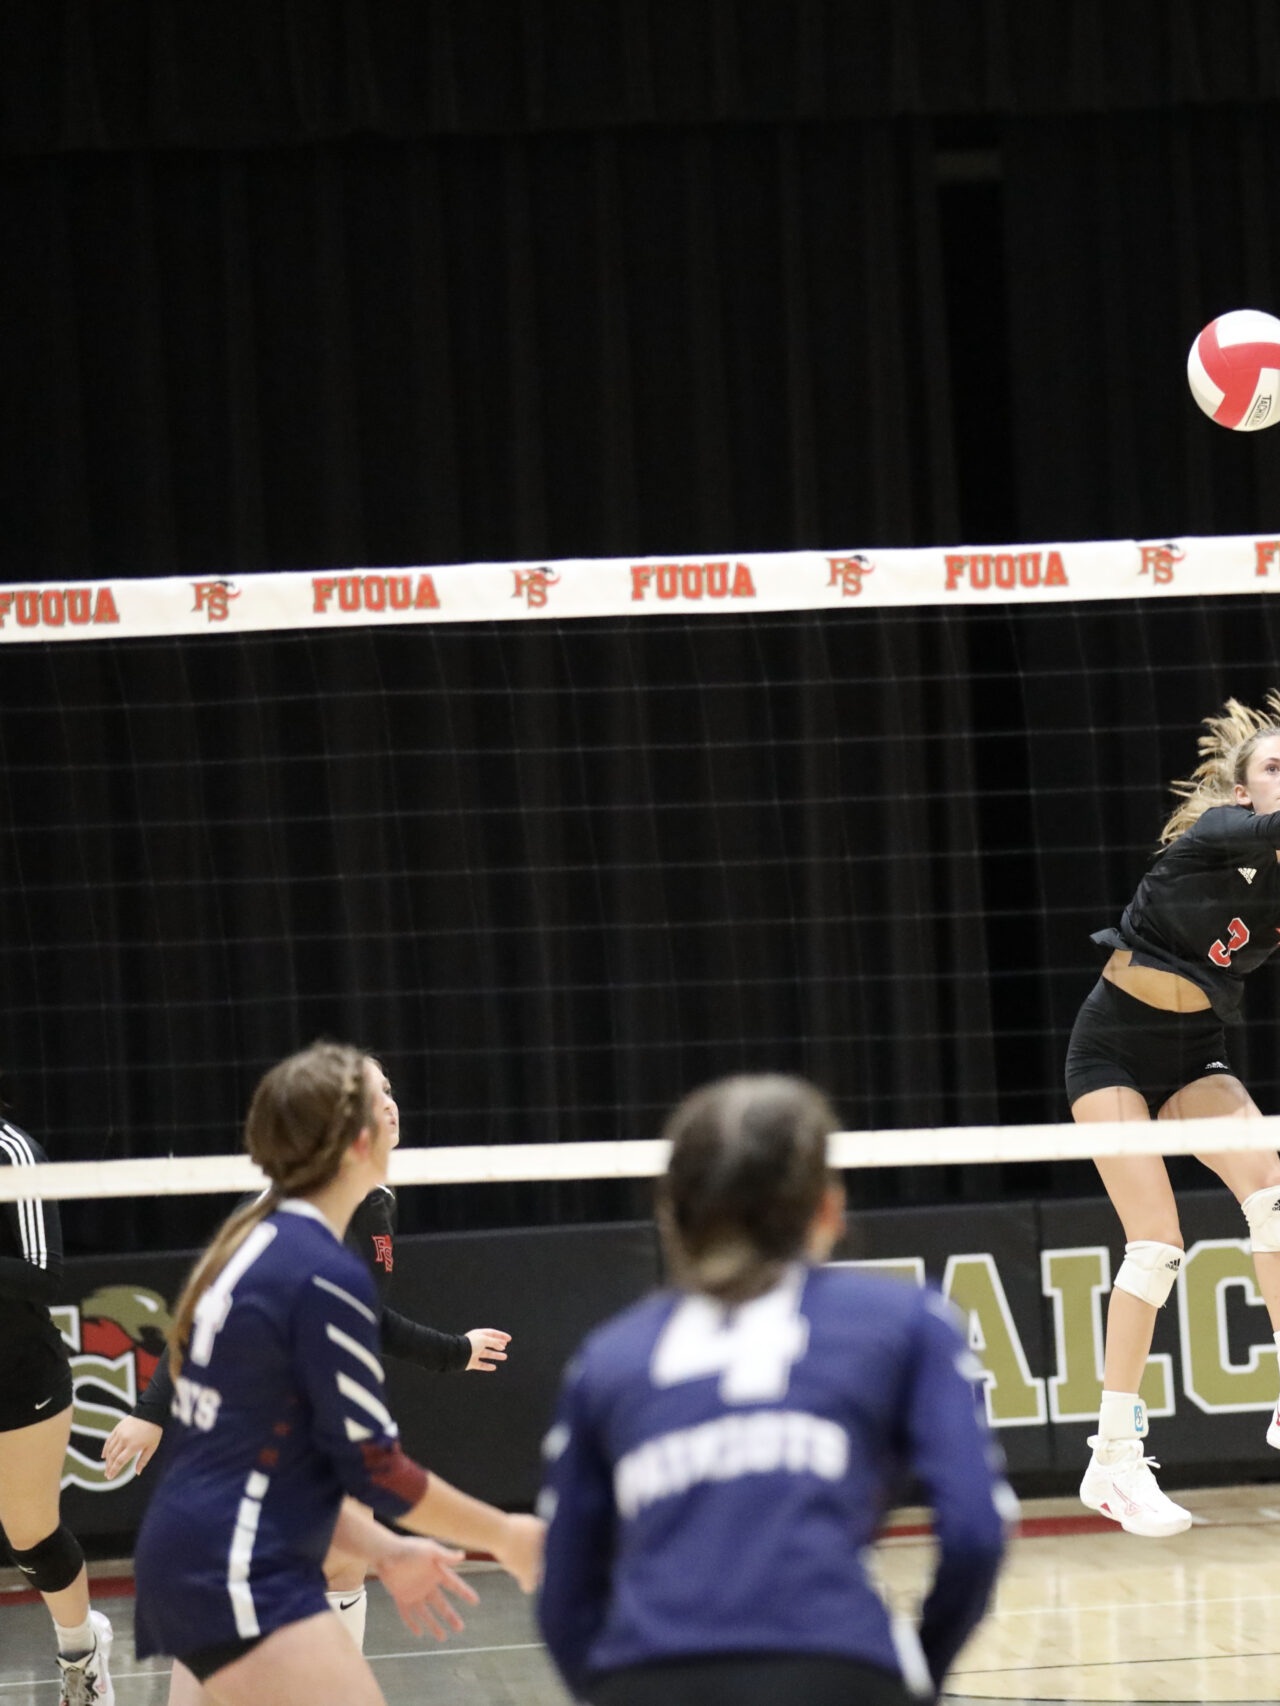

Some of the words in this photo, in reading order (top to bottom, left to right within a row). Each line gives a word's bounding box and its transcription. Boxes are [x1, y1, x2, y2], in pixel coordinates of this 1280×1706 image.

[0, 586, 120, 629] FUQUA
[311, 574, 441, 614] FUQUA
[630, 562, 757, 601] FUQUA
[944, 551, 1069, 591] FUQUA
[1207, 916, 1251, 968] 3
[650, 1264, 811, 1405] 4
